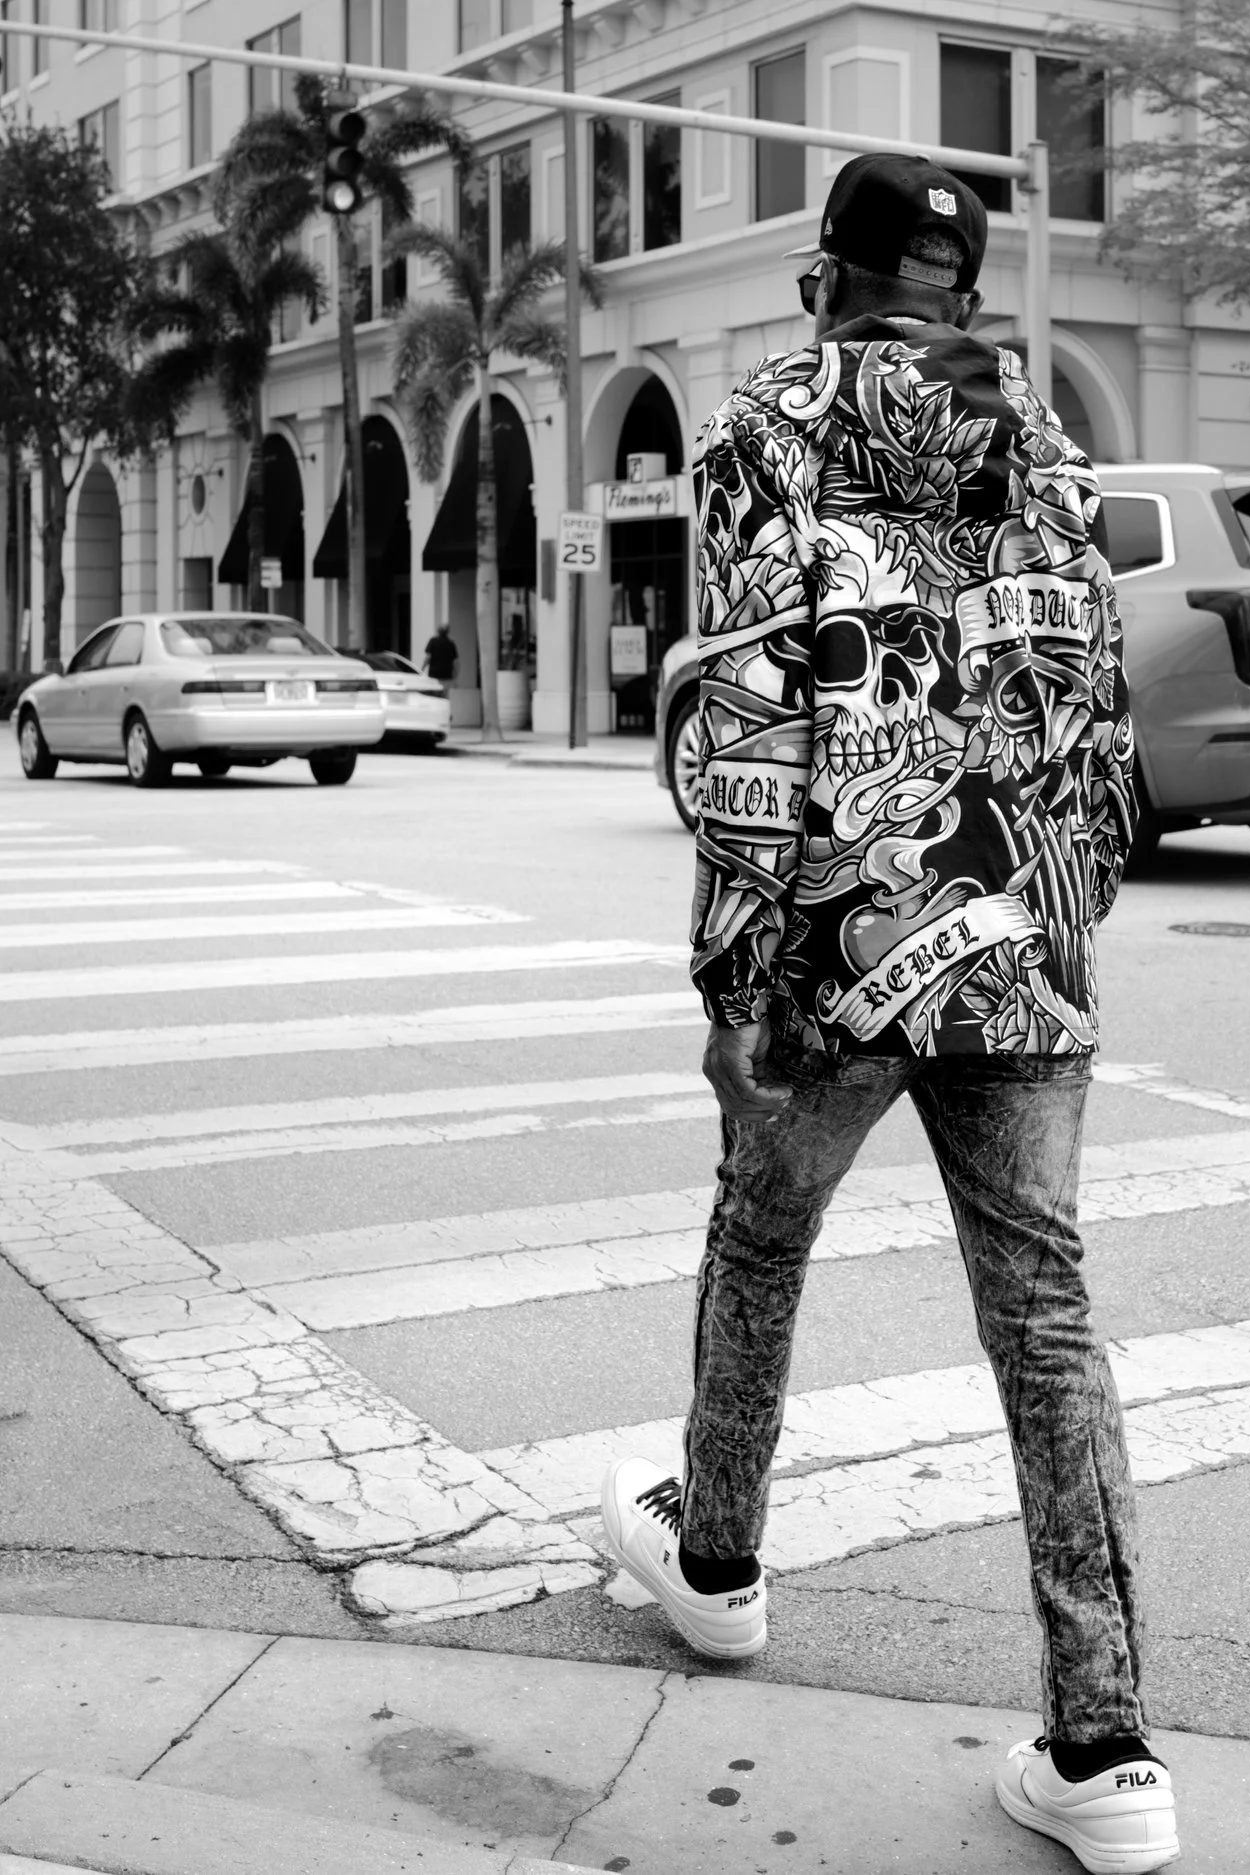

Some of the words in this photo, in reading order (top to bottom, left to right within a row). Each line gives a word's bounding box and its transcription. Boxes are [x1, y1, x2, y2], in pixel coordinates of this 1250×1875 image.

[563, 518, 600, 530] SPEED
[565, 530, 594, 541] LIMIT
[563, 543, 596, 565] 25
[859, 916, 980, 1015] REBEL
[727, 1590, 758, 1609] FILA
[1114, 1769, 1157, 1789] FILA
